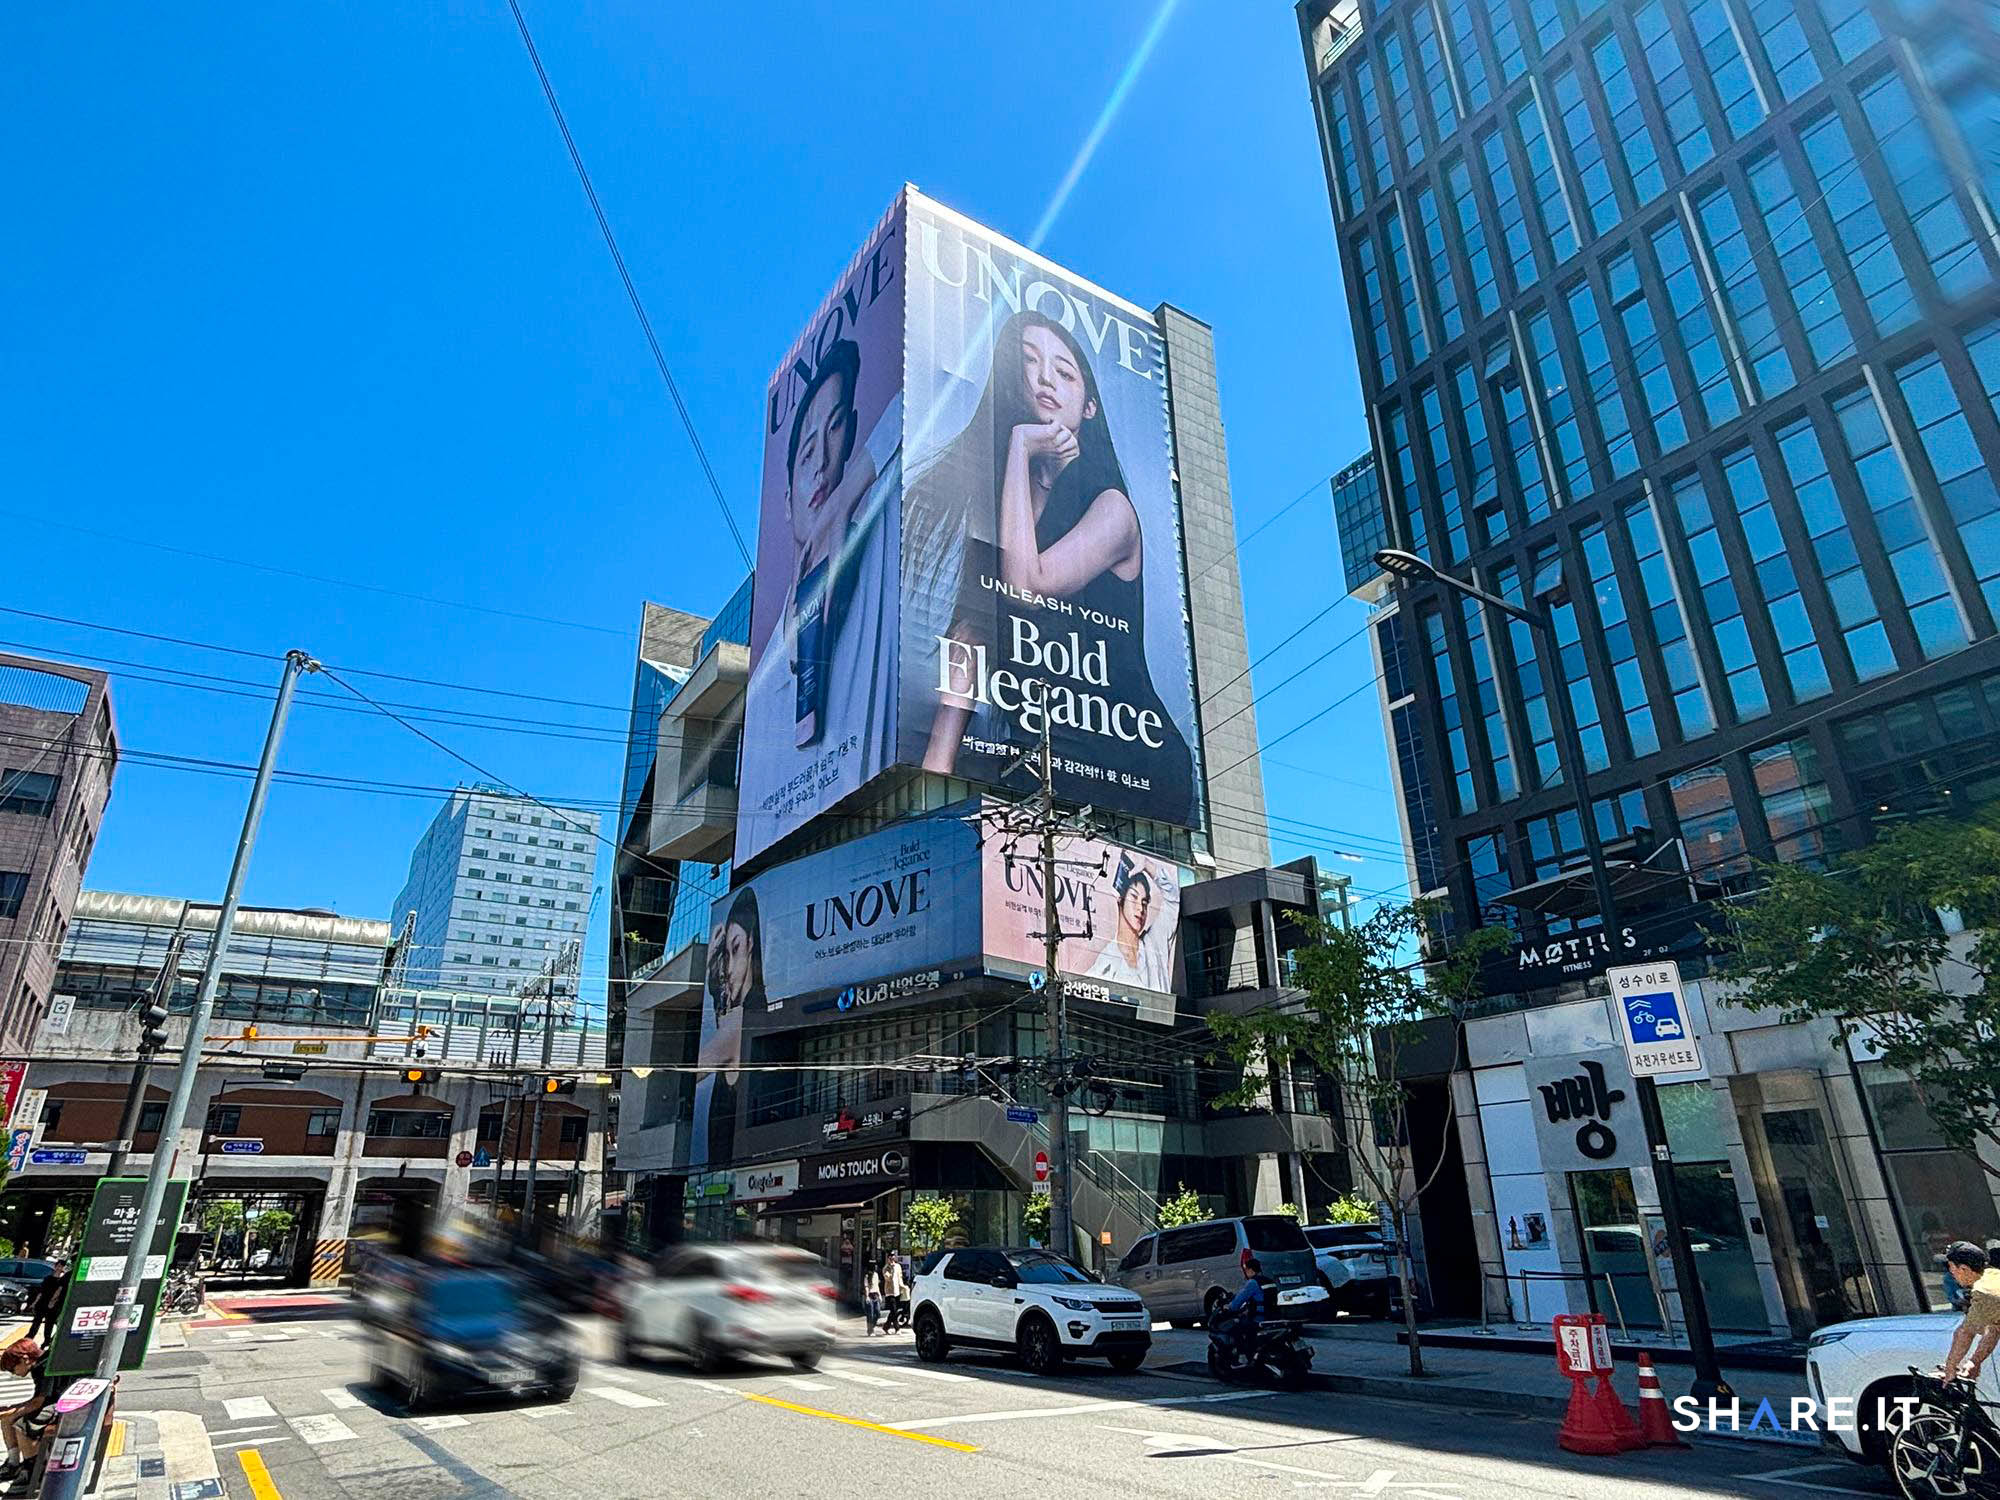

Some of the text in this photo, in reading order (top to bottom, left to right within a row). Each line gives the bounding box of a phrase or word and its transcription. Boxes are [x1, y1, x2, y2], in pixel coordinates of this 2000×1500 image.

[769, 229, 896, 435] UNOVE
[918, 220, 1154, 381] UNOVE
[980, 574, 1130, 635] UNLEASH YOUR
[1008, 614, 1109, 687] Bold
[934, 634, 1164, 749] Elegance
[806, 868, 931, 941] UNOVE
[1562, 960, 1593, 974] FITNESS
[1618, 971, 1672, 990] 성수이로
[1633, 1050, 1695, 1068] 자전거우선도로
[1536, 1060, 1625, 1160] 빵
[818, 1157, 879, 1180] MOM'S TOUCH
[1568, 1328, 1584, 1368] 주차금지
